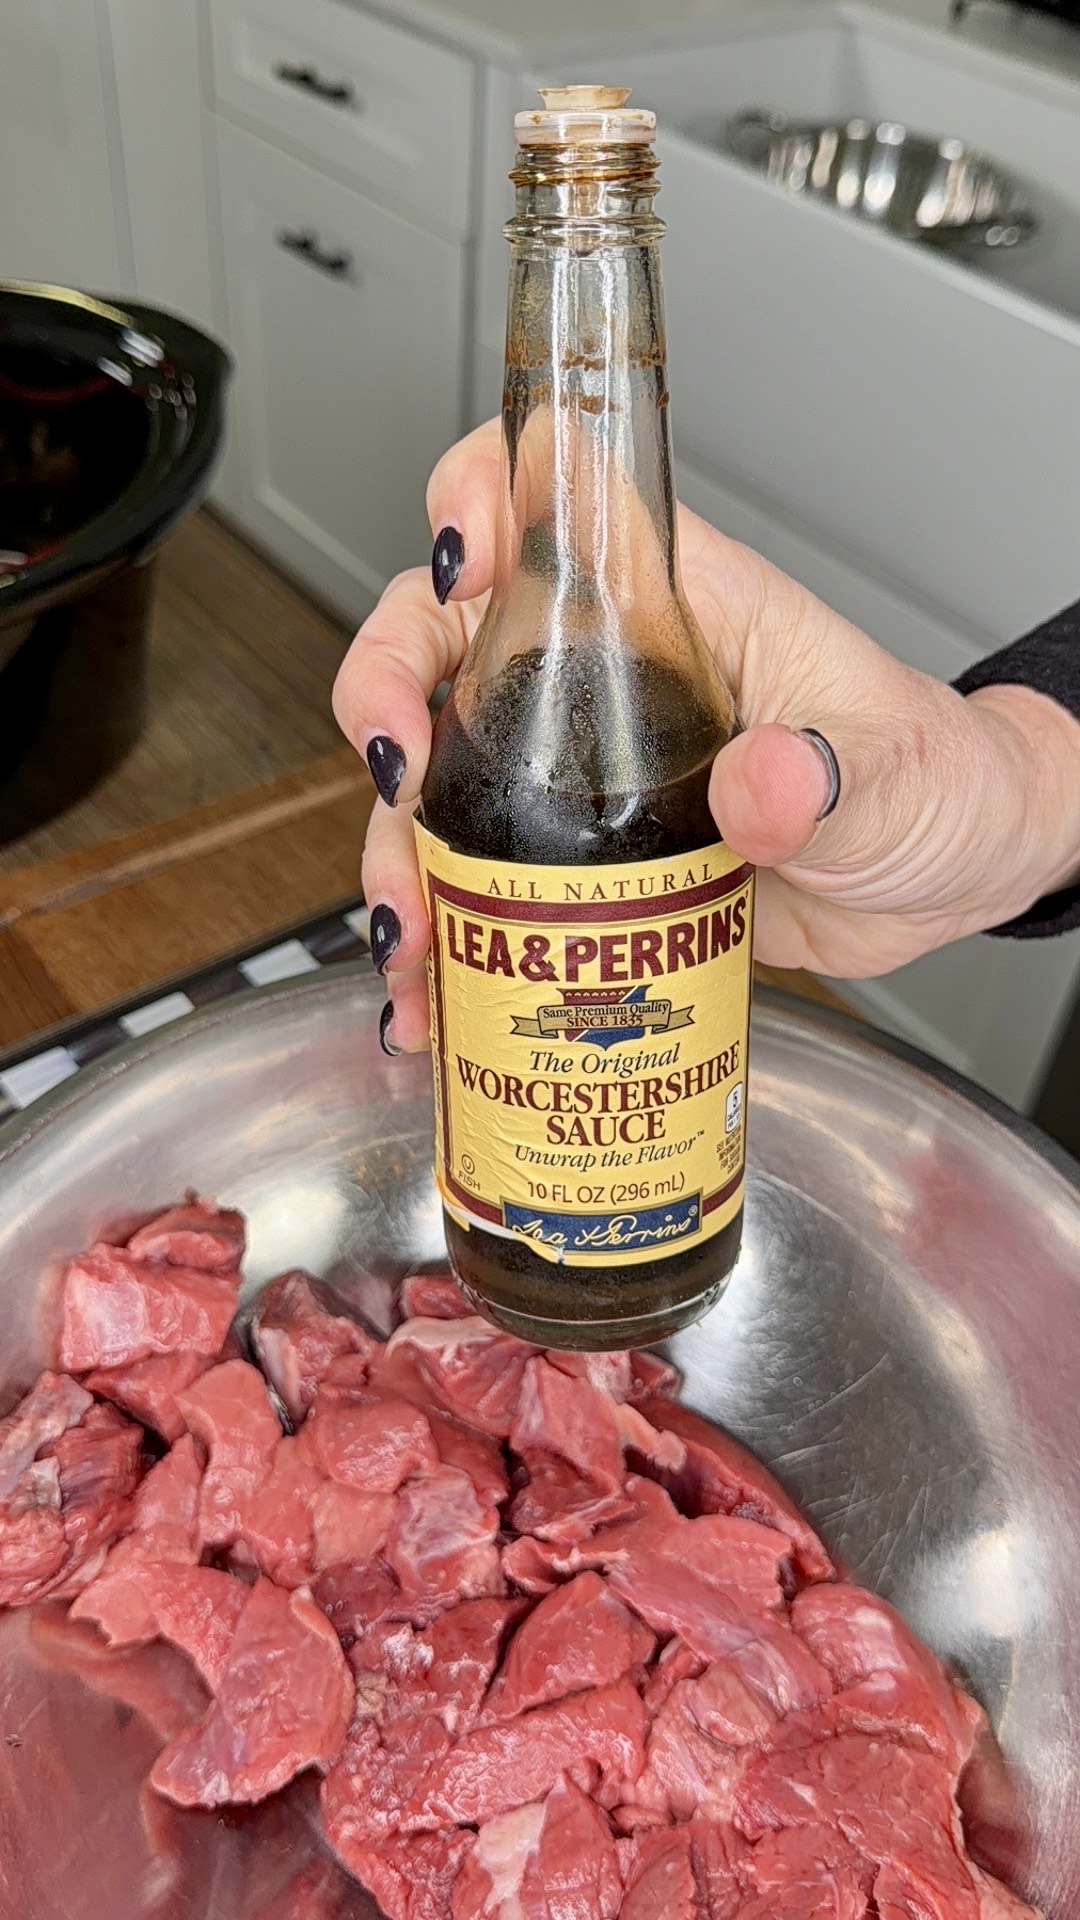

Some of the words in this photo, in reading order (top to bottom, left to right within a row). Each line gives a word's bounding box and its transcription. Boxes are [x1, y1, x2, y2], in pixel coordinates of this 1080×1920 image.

[488, 877, 543, 900] ALL
[564, 863, 714, 901] NATURAL
[543, 1006, 573, 1019] Same
[574, 1005, 628, 1018] Premium
[630, 999, 669, 1017] Quality
[566, 1015, 609, 1028] SINCE
[612, 1014, 644, 1027] 1835
[455, 1040, 741, 1114] WORCESTERSHIRE
[530, 1050, 573, 1073] The
[580, 1043, 681, 1078] Original
[547, 1109, 666, 1147] SAUCE
[514, 1144, 598, 1172] Unwrap
[602, 1147, 633, 1167] the
[458, 1170, 481, 1191] FISH
[527, 1182, 548, 1199] 10
[552, 1184, 572, 1203] FL
[575, 1186, 605, 1203] OZ
[610, 1184, 650, 1205] (296
[655, 1171, 685, 1200] mL)
